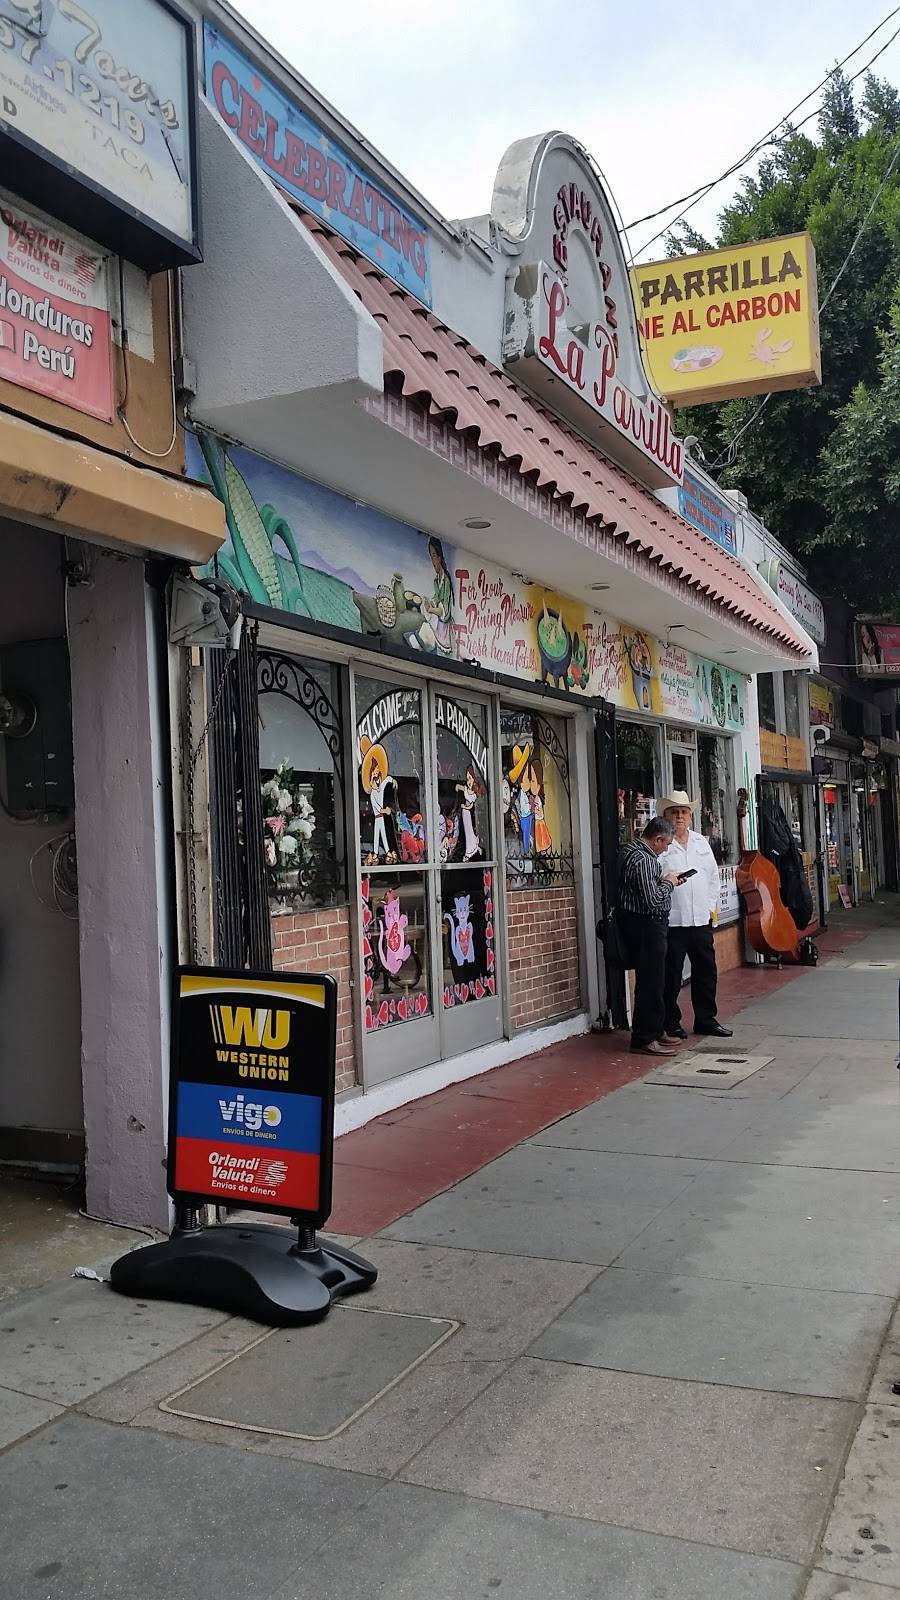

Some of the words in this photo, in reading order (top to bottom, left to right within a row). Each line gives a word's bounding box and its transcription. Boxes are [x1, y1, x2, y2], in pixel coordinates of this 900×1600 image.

[212, 60, 427, 283] CELEBRATING
[1, 208, 65, 256] Orlandi
[7, 229, 60, 272] Valuta
[43, 271, 55, 282] de
[58, 278, 87, 299] dinero
[641, 250, 802, 308] PARRILLA
[672, 309, 700, 335] AL
[706, 289, 801, 328] CARBON
[23, 330, 76, 379] Perú
[539, 273, 585, 390] La
[593, 324, 683, 480] Parrilla
[455, 569, 478, 610] For
[478, 569, 505, 611] Your
[465, 603, 502, 639] Dining
[447, 702, 487, 780] PARRILLA
[212, 1005, 291, 1050] WU
[216, 1050, 289, 1068] WESTERN
[238, 1065, 289, 1081] UNION
[218, 1094, 282, 1130] vigo
[254, 1131, 277, 1140] DINERO
[208, 1152, 260, 1170] Orlandi
[212, 1166, 255, 1183] Valuta
[238, 1184, 248, 1192] de
[250, 1186, 276, 1196] dinero
